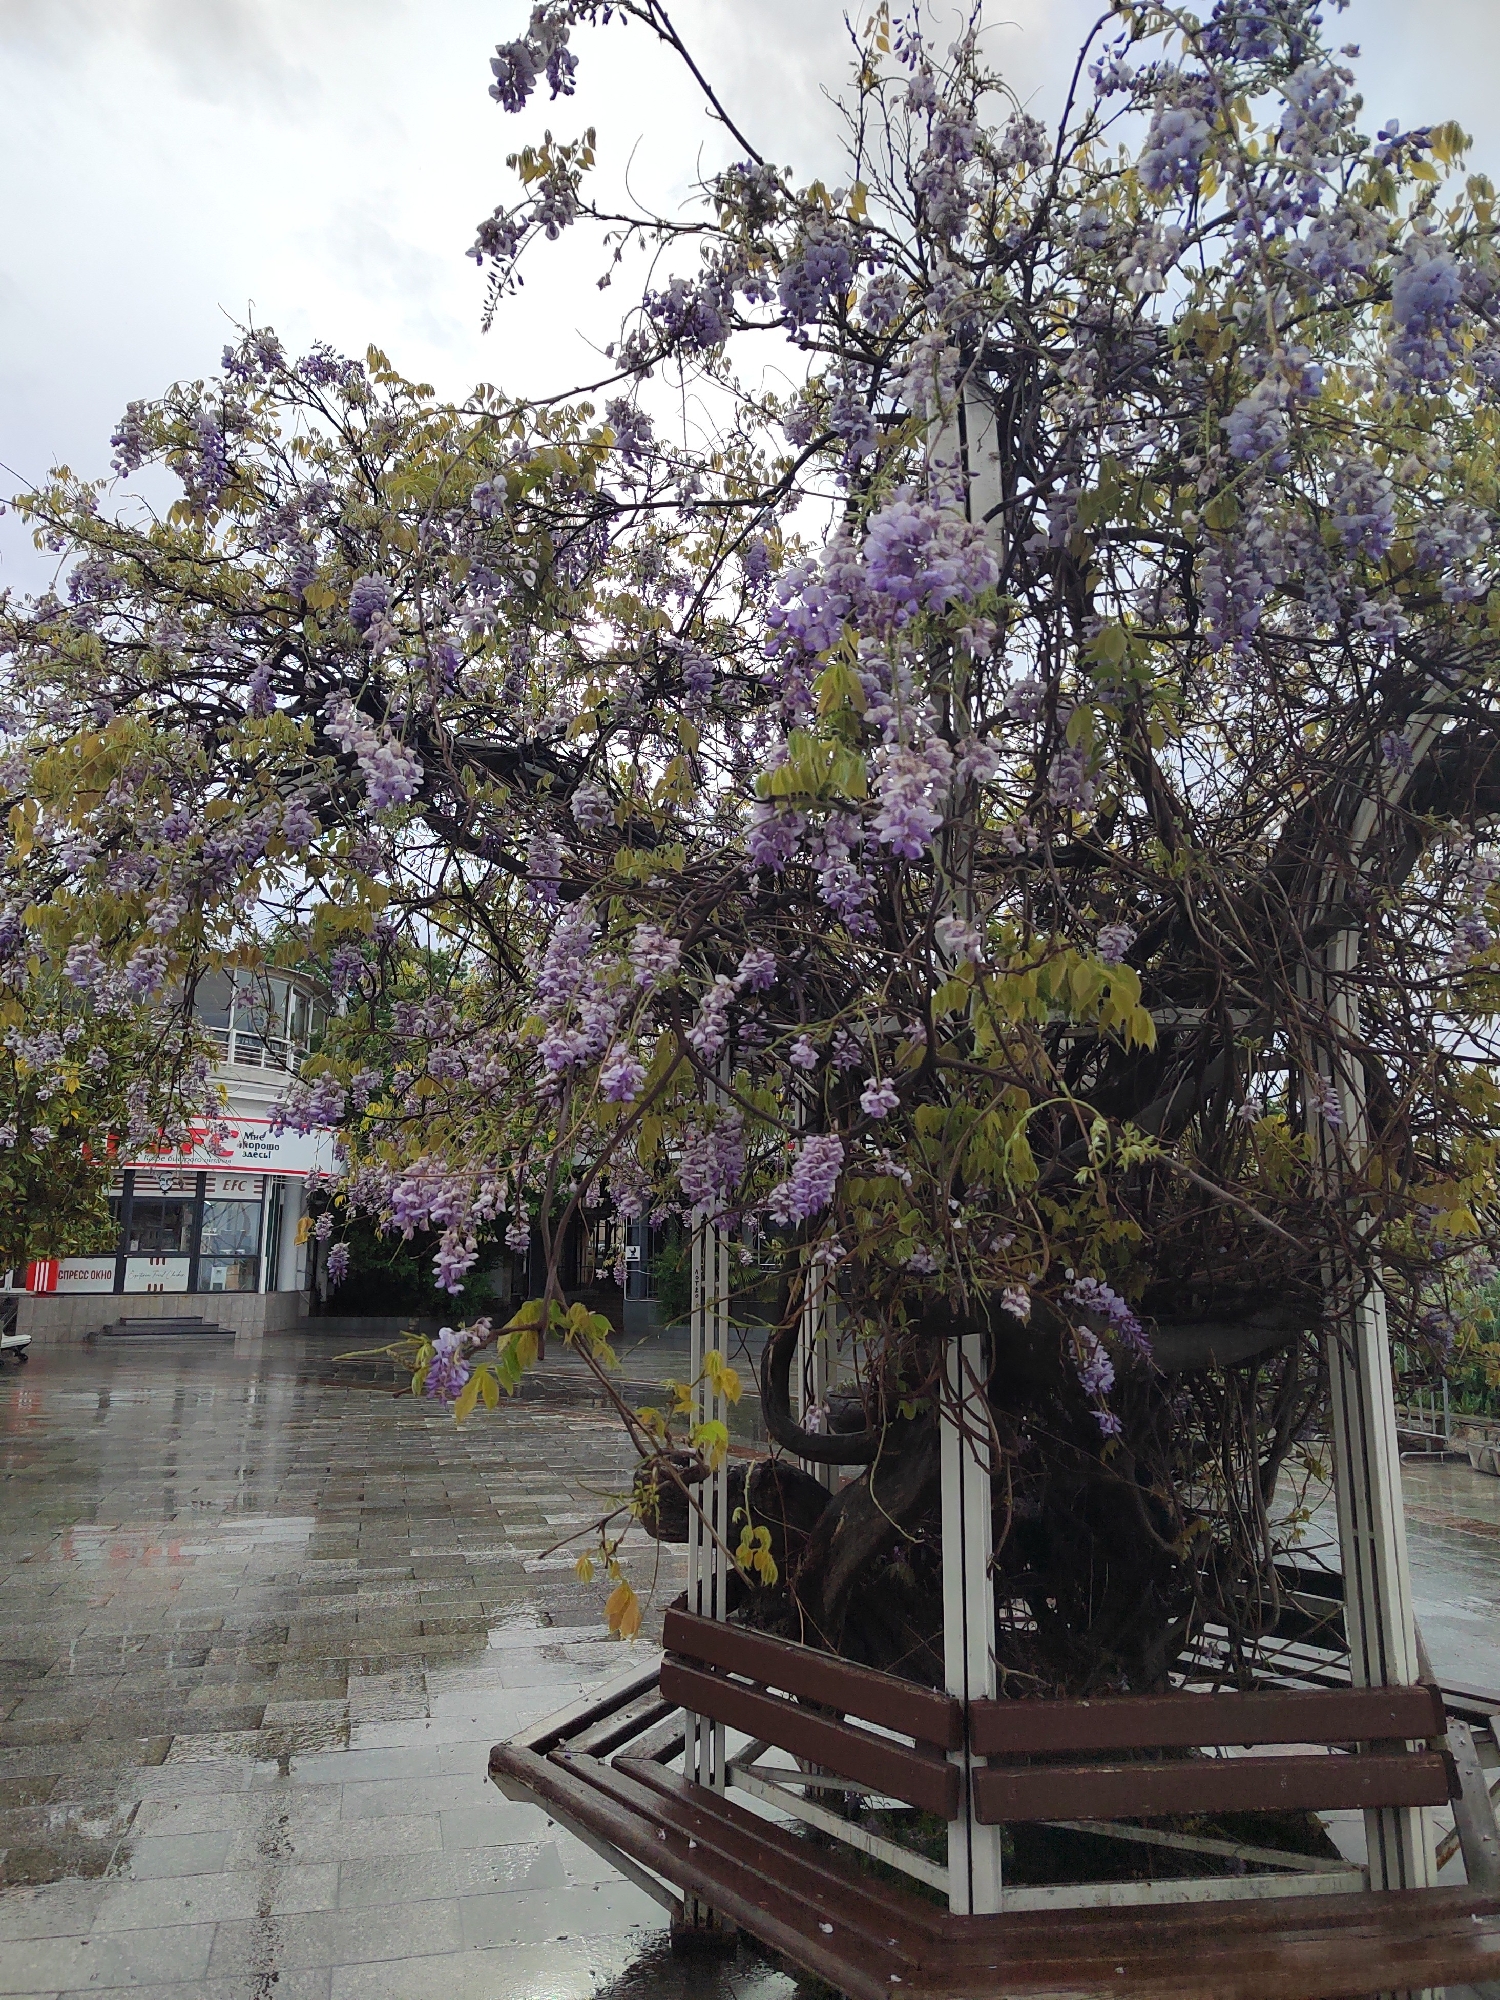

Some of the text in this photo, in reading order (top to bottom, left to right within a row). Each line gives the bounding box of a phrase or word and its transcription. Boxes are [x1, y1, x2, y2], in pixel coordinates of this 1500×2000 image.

[243, 1131, 265, 1142] Мне
[242, 1151, 271, 1159] здесь!
[222, 1179, 247, 1191] EFC
[90, 1269, 112, 1280] ОКНО
